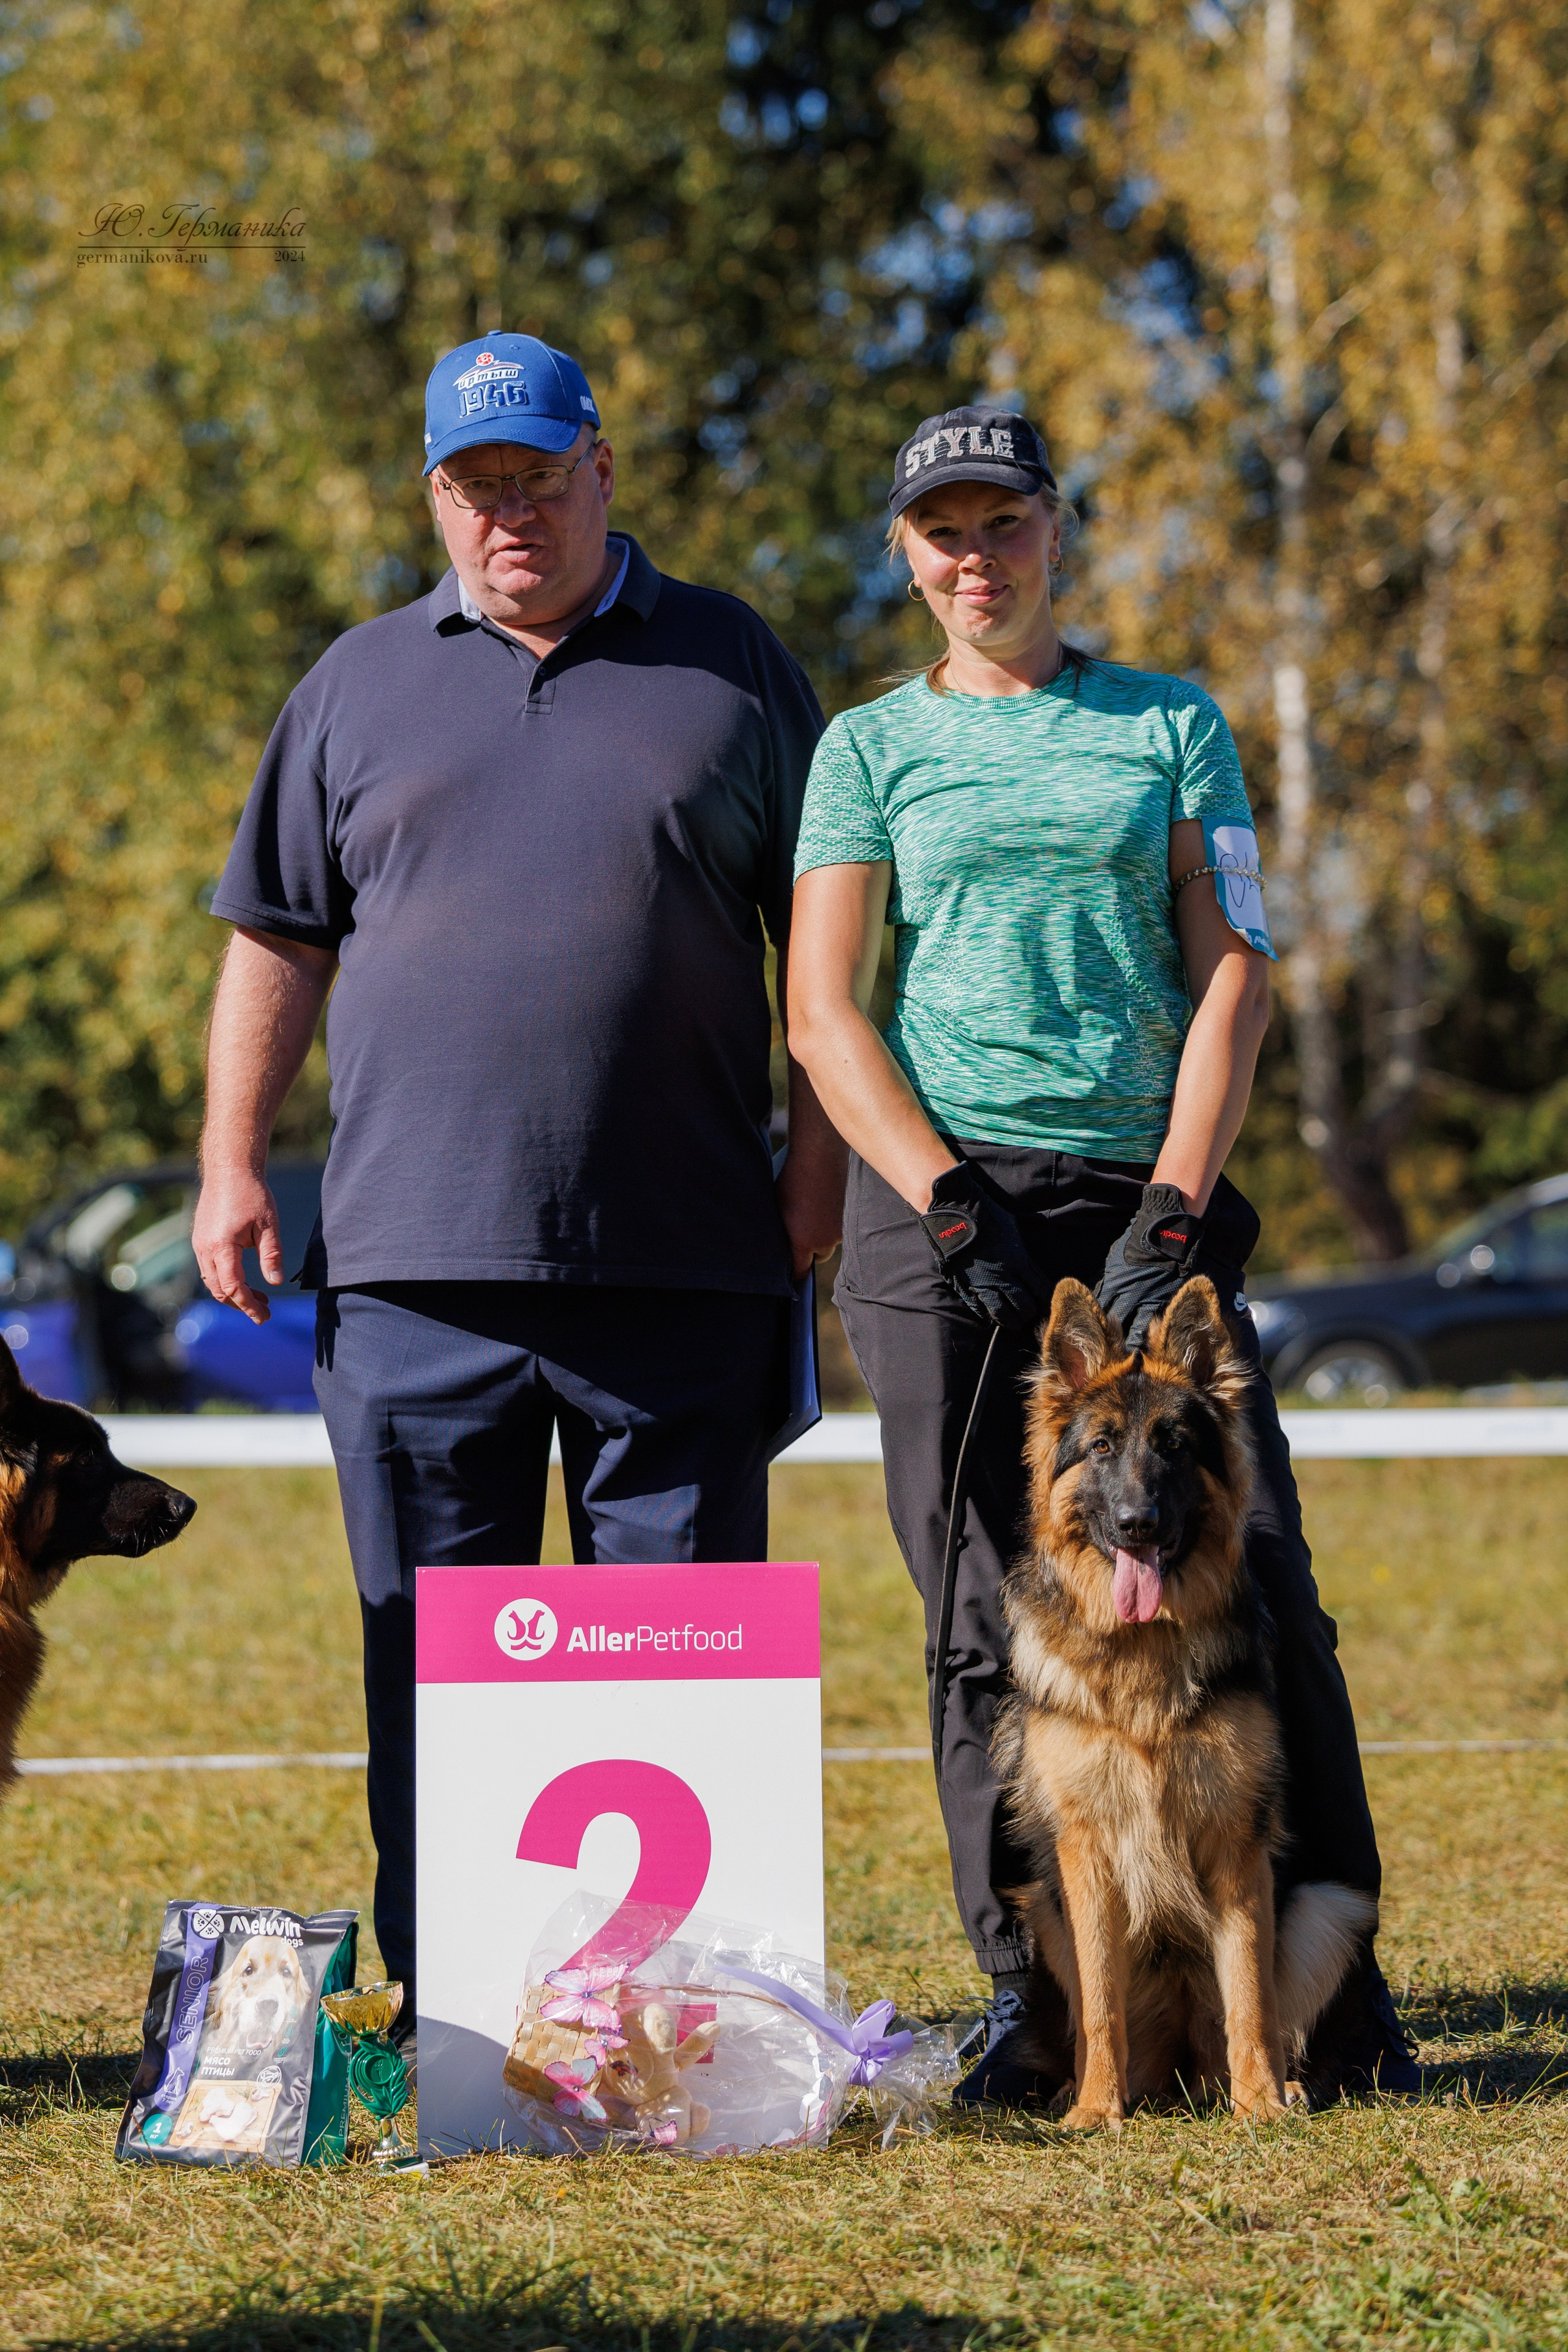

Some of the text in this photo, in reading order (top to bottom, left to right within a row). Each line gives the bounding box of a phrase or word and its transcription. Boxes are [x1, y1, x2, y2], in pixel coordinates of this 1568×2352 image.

[458, 381, 527, 418] 1946
[905, 426, 1015, 478] STYLE
[567, 1624, 742, 1652] AllerPetfood
[516, 1760, 717, 2064] 2
[230, 1915, 301, 1937] Melwin
[281, 1936, 304, 1948] dogs
[176, 1955, 209, 2045] SENIOR
[201, 2067, 235, 2077] ПТИЦЫ
[204, 2056, 231, 2065] МЯСО
[153, 2122, 162, 2133] 1
